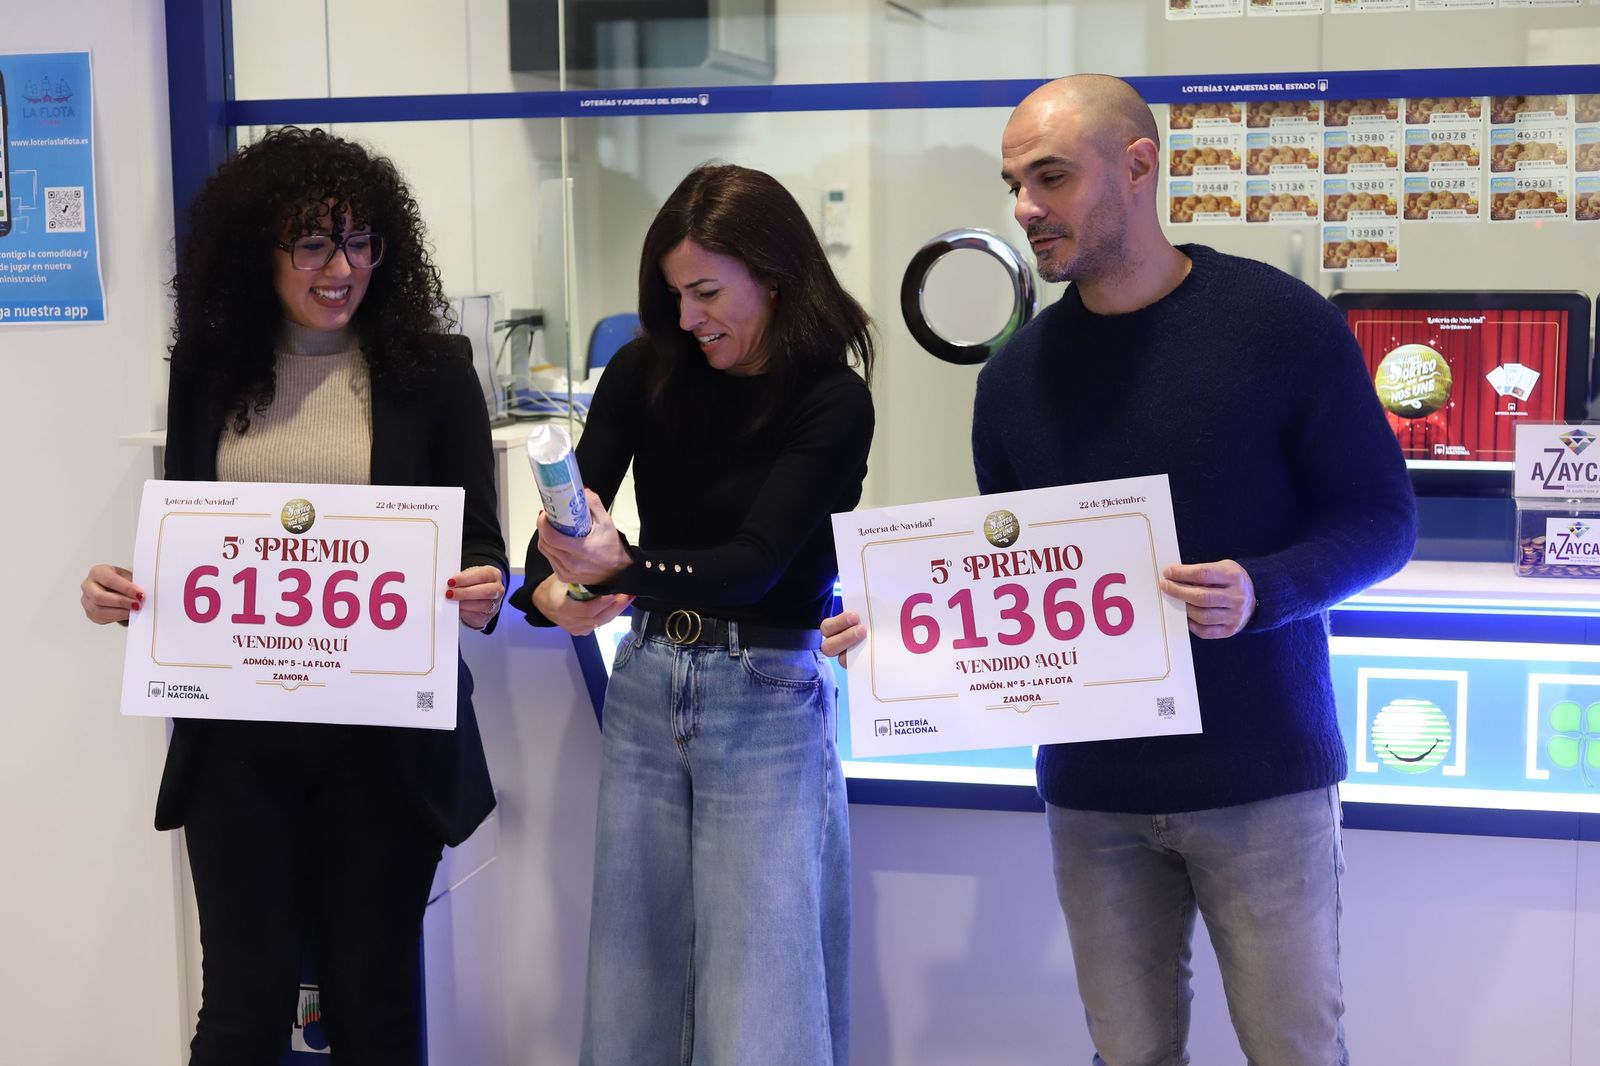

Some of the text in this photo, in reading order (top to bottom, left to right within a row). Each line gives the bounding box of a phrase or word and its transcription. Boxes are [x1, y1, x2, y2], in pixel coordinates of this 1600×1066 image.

[1182, 82, 1316, 93] LOTERÍAS Y APUESTAS DEL ESTADO
[580, 98, 616, 107] LOTERÍAS
[622, 98, 656, 106] APUESTAS
[657, 97, 670, 105] DEL
[670, 97, 698, 105] ESTADO
[23, 106, 76, 119] LA FLOTA
[1351, 133, 1385, 142] 13980
[1431, 132, 1467, 140] 00378
[1517, 130, 1552, 139] 46301
[11, 137, 89, 147] www.loteriaslaflota.es
[1351, 181, 1385, 190] 13980
[1430, 180, 1466, 189] 00378
[1517, 179, 1552, 188] 46301
[1351, 229, 1384, 237] 13980
[28, 249, 36, 258] la
[37, 249, 82, 258] comodidad
[83, 250, 88, 259] y
[10, 263, 31, 273] jugar
[44, 263, 72, 271] nuetra
[14, 305, 61, 317] nuestra
[64, 306, 89, 320] app
[1391, 378, 1435, 403] NOS UNE
[1531, 448, 1600, 490] AZAYC
[193, 497, 203, 505] de
[204, 497, 238, 506] Navidad
[375, 501, 440, 511] 22 de Diciembre
[1078, 495, 1147, 509] 22 de Diciembre
[889, 524, 900, 532] de
[900, 517, 936, 530] Navidad
[254, 537, 370, 564] PREMIO
[962, 544, 1084, 581] PREMIO
[183, 565, 408, 631] 61366
[899, 572, 1135, 655] 61366
[232, 634, 349, 655] VENDIDO AQUÍ
[242, 656, 277, 666] ADMÓN.
[290, 659, 296, 667] 5
[315, 661, 341, 669] FLOTA
[956, 647, 1078, 674] VENDIDO AQUÍ
[272, 673, 309, 681] ZAMORA
[167, 684, 202, 692] LOTERÍA
[969, 680, 1006, 691] ADMÓN.
[1032, 678, 1044, 686] LA
[1045, 676, 1073, 686] FLOTA
[167, 691, 210, 700] NACIONAL
[1003, 693, 1041, 704] ZAMORA
[894, 718, 929, 728] LOTERÍA
[894, 726, 939, 735] NACIONAL
